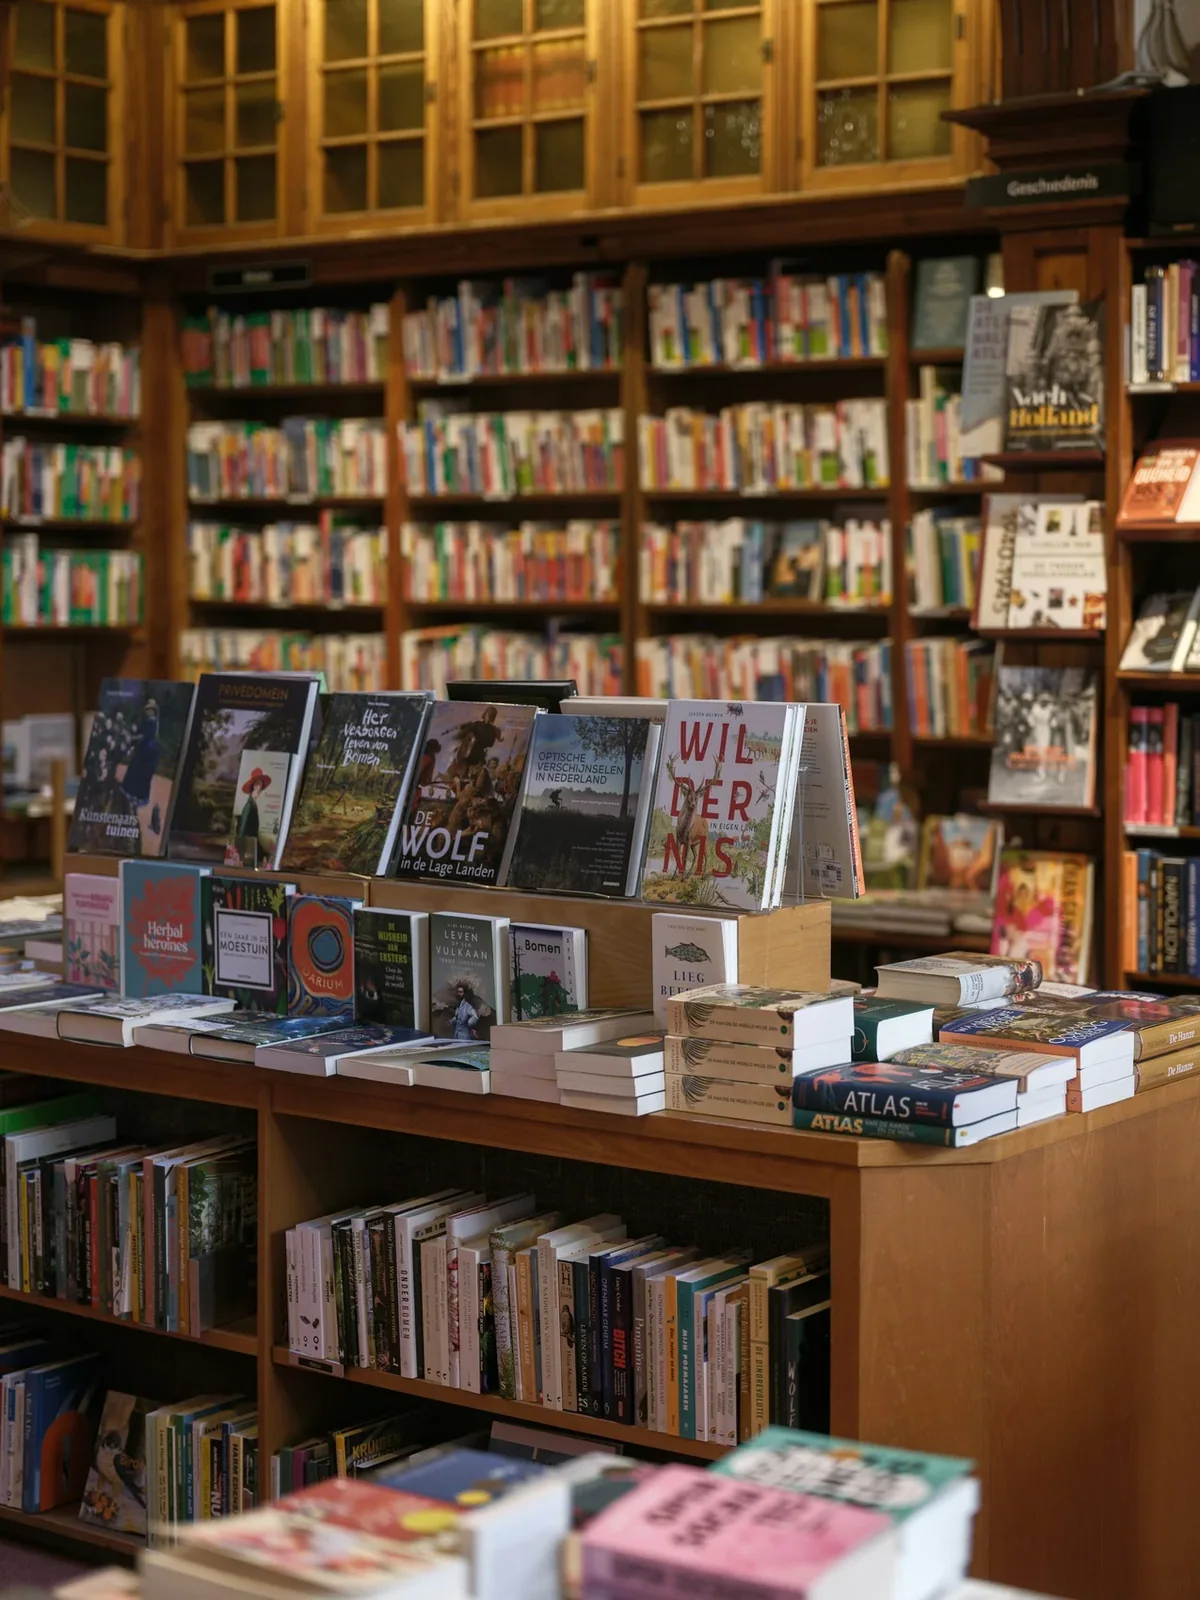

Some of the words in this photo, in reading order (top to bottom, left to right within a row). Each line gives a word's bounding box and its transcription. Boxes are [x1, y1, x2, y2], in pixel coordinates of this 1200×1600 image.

[681, 721, 753, 764] WIL
[340, 750, 380, 766] Bomen
[539, 752, 586, 762] OPTISCHE
[537, 762, 624, 775] VERSCHIJNSELEN
[535, 772, 545, 781] IN
[547, 773, 607, 784] NEDERLAND
[670, 777, 752, 822] DER
[415, 811, 433, 825] DE
[106, 824, 139, 839] tuinen
[402, 825, 488, 862] WOLF
[662, 833, 734, 877] NIS
[401, 857, 411, 869] in
[413, 859, 426, 871] de
[429, 862, 453, 876] Lage
[456, 864, 494, 878] Landen
[148, 921, 182, 938] Herbal
[444, 930, 478, 942] LEVEN
[144, 934, 188, 953] heroines
[220, 940, 268, 954] MOESTUIN
[525, 940, 561, 954] Bomen
[436, 946, 488, 960] VULKAAN
[674, 971, 704, 983] LIEG
[1169, 1034, 1178, 1044] De
[1168, 1066, 1176, 1076] De
[844, 1091, 911, 1118] ATLAS
[811, 1114, 863, 1134] ATLAS
[561, 1264, 571, 1272] De
[562, 1272, 570, 1286] H
[401, 1270, 410, 1339] ONDERBOMEN
[613, 1328, 626, 1369] BITCH
[634, 1317, 644, 1372] Pinguïns
[756, 1347, 763, 1356] DE
[581, 1352, 587, 1364] OP
